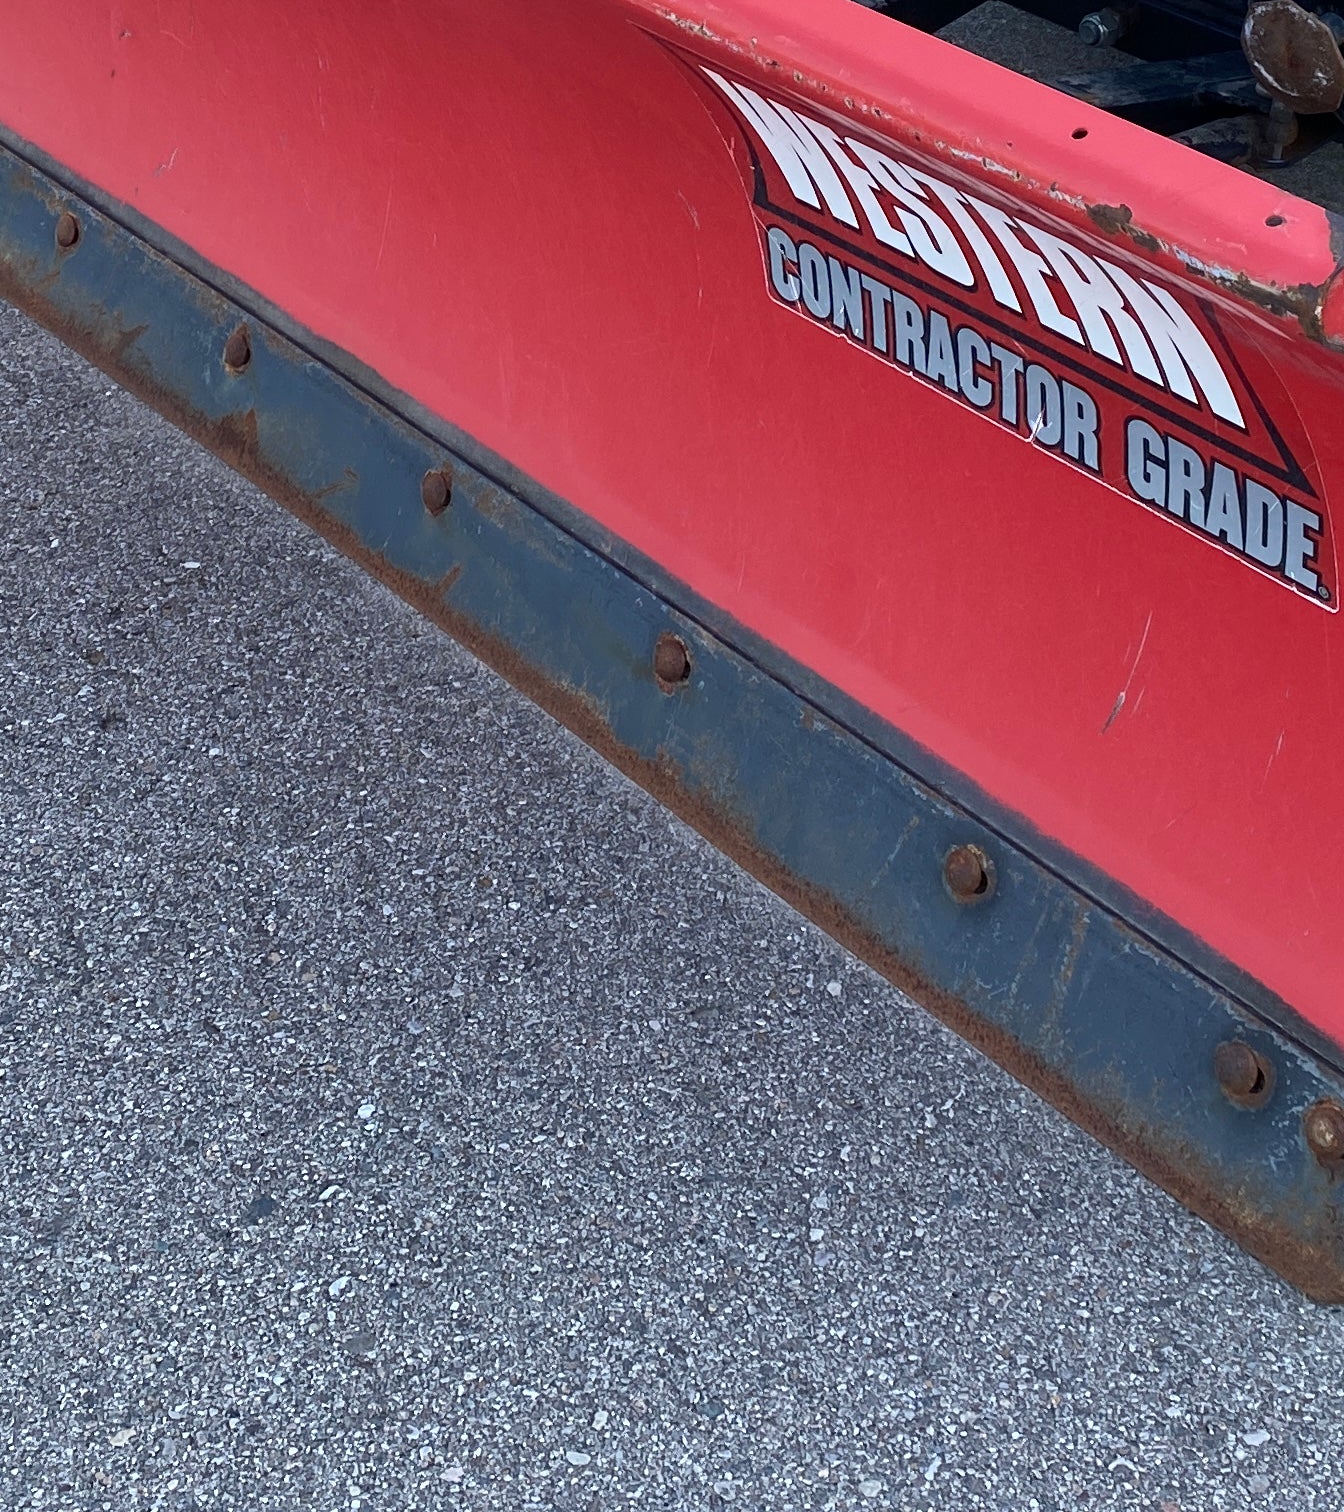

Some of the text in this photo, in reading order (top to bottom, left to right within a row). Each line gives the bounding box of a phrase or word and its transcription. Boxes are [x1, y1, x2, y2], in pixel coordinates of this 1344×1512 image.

[699, 65, 1247, 429] WESTERN
[765, 226, 1320, 594] CONTRACTOR GRADE
